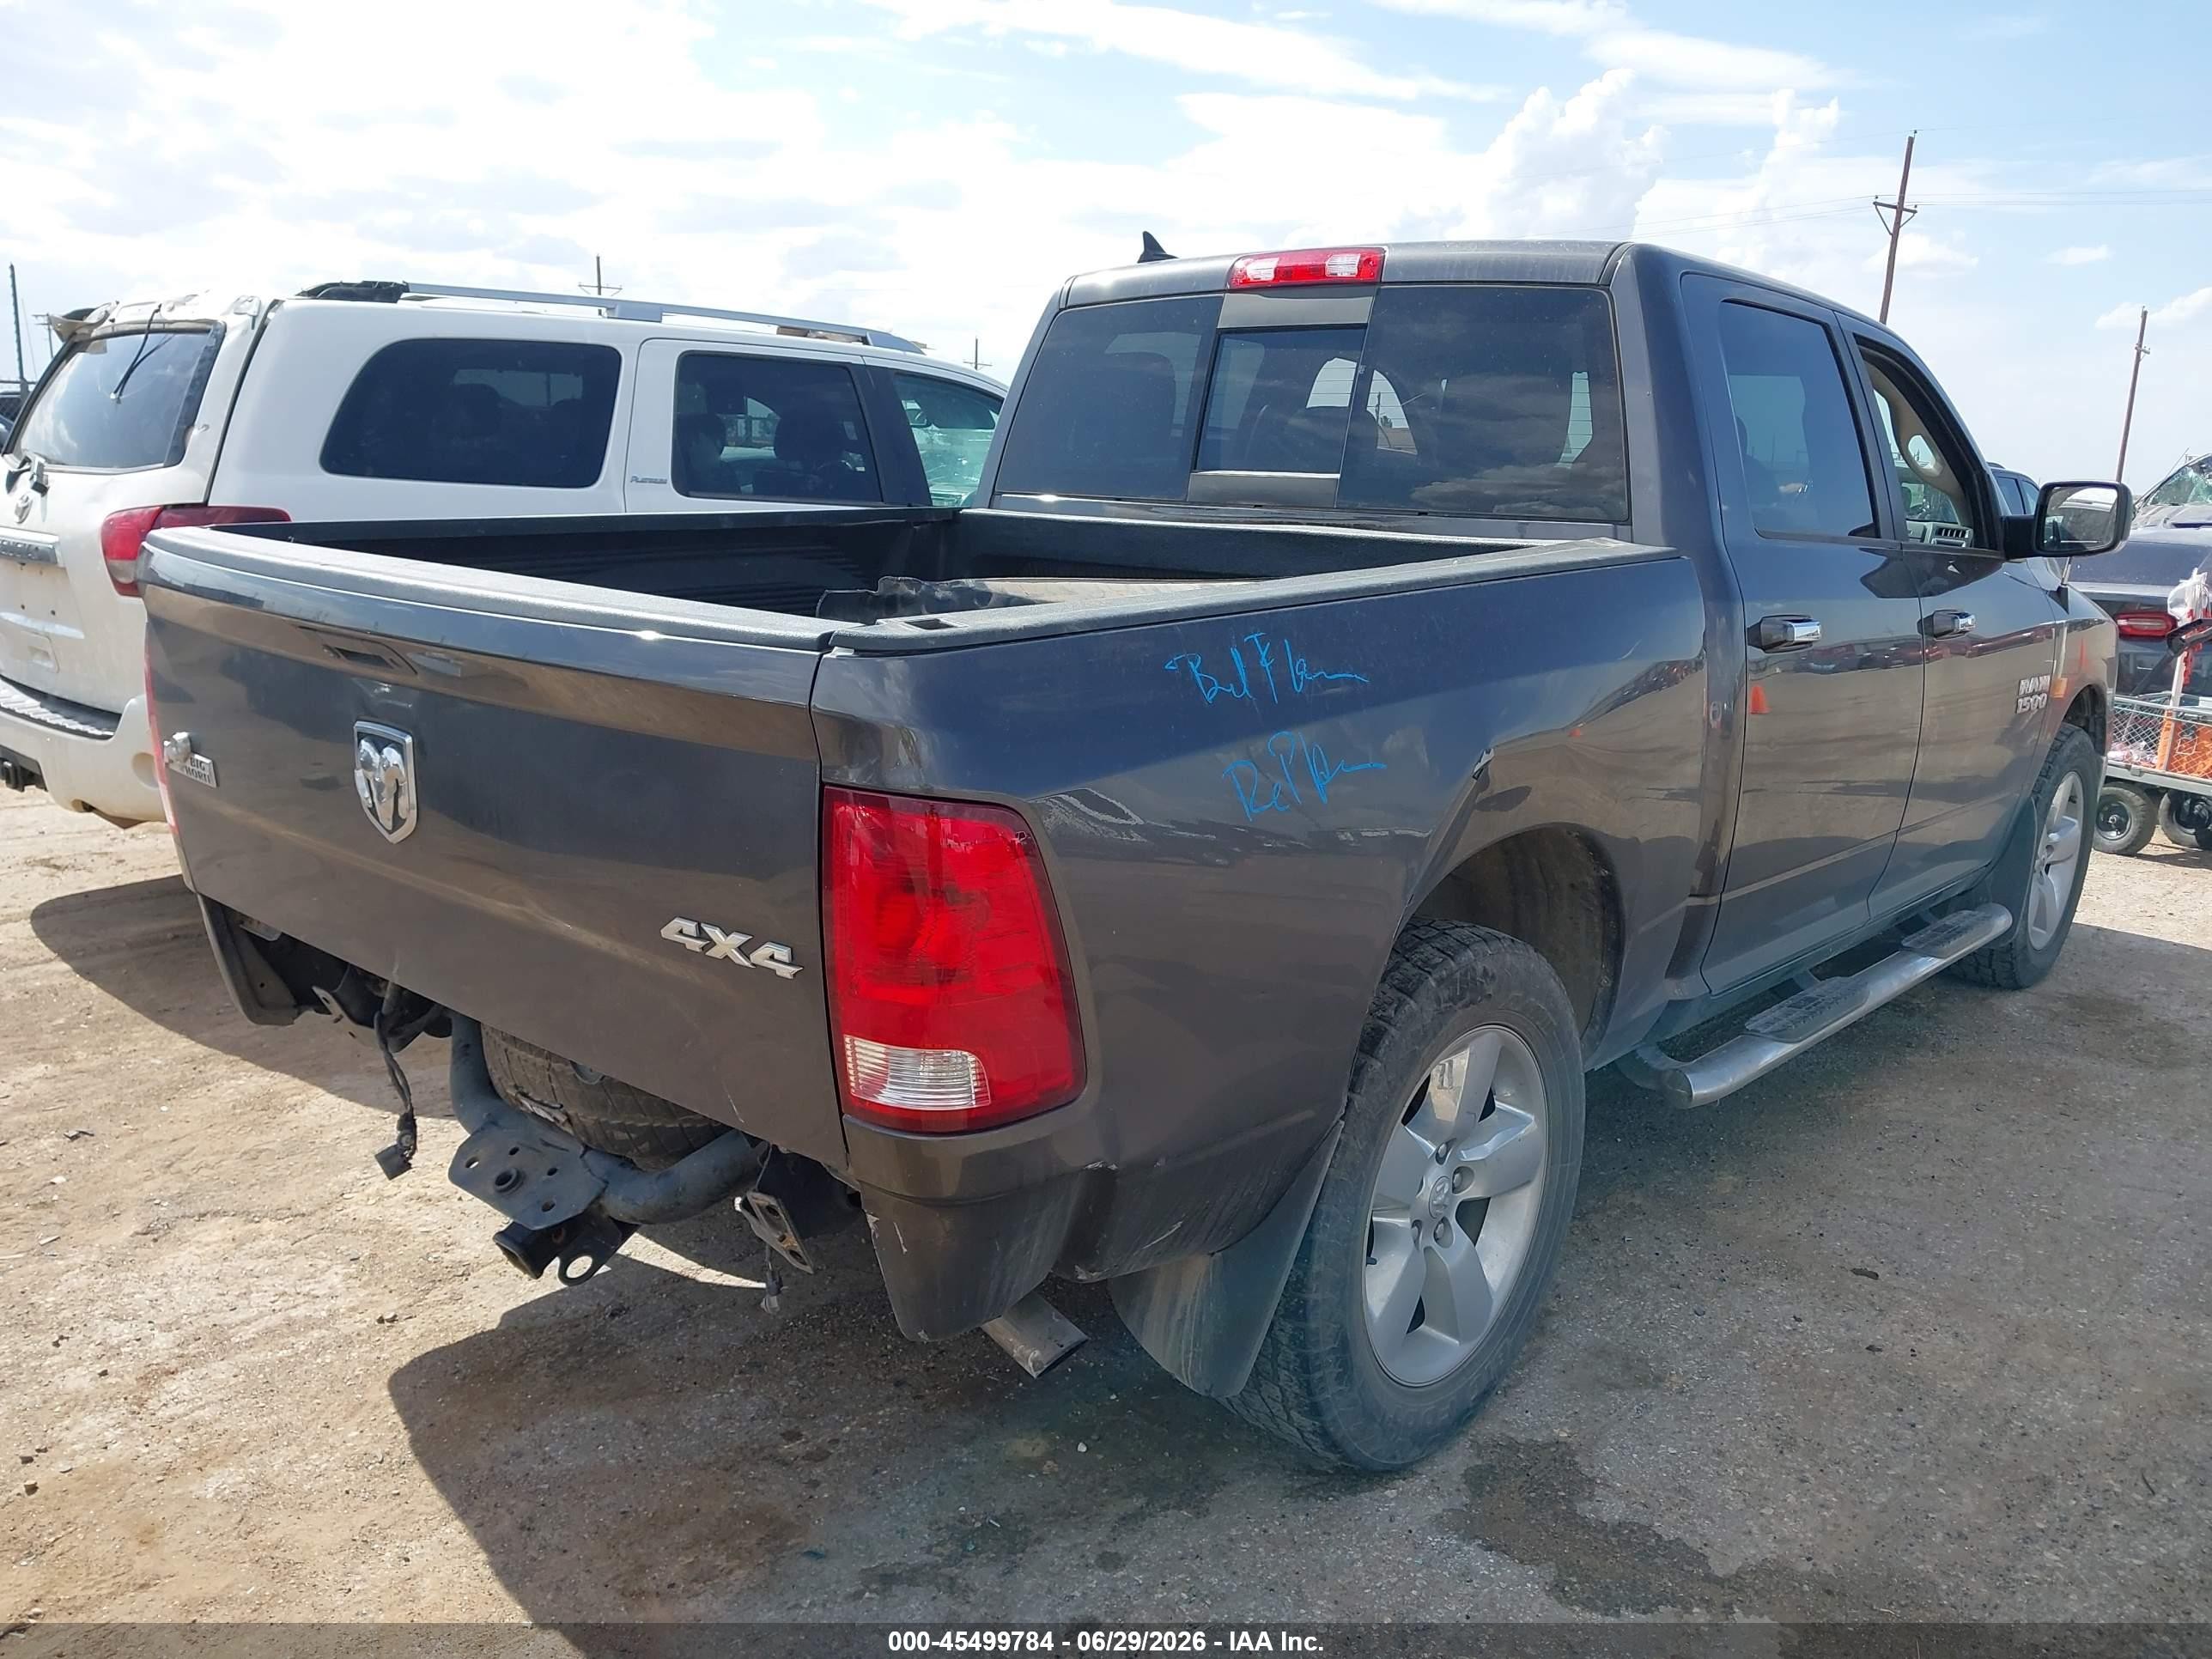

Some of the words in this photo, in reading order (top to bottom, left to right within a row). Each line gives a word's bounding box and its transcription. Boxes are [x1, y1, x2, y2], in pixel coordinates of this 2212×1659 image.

[2018, 675, 2051, 696] RAM
[2016, 692, 2048, 714] 1500
[189, 756, 206, 771] BIG
[185, 765, 211, 784] HORN
